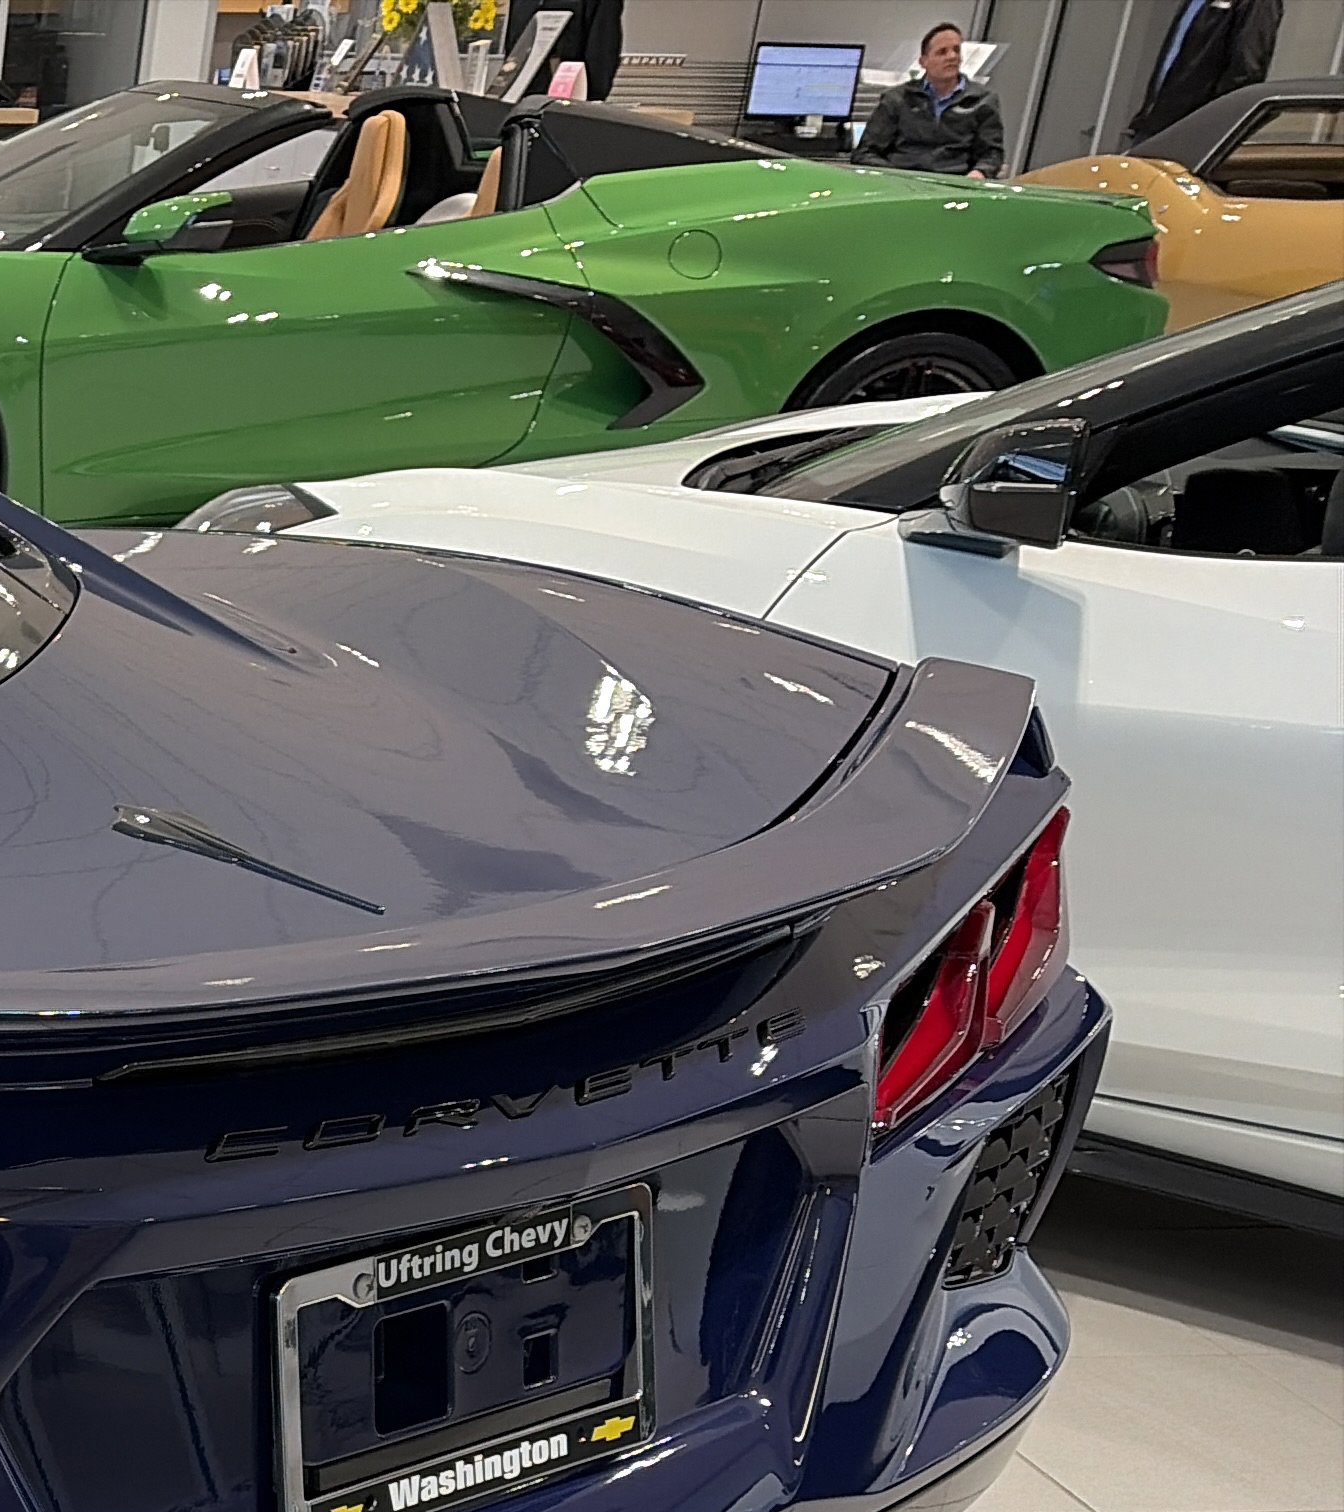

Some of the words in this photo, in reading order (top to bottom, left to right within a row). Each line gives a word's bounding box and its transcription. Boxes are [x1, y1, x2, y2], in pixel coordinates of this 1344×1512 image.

[205, 1007, 807, 1163] CORVETTE
[378, 1244, 480, 1288] Uftring
[485, 1218, 569, 1258] Chevy
[388, 1433, 569, 1511] Washington
